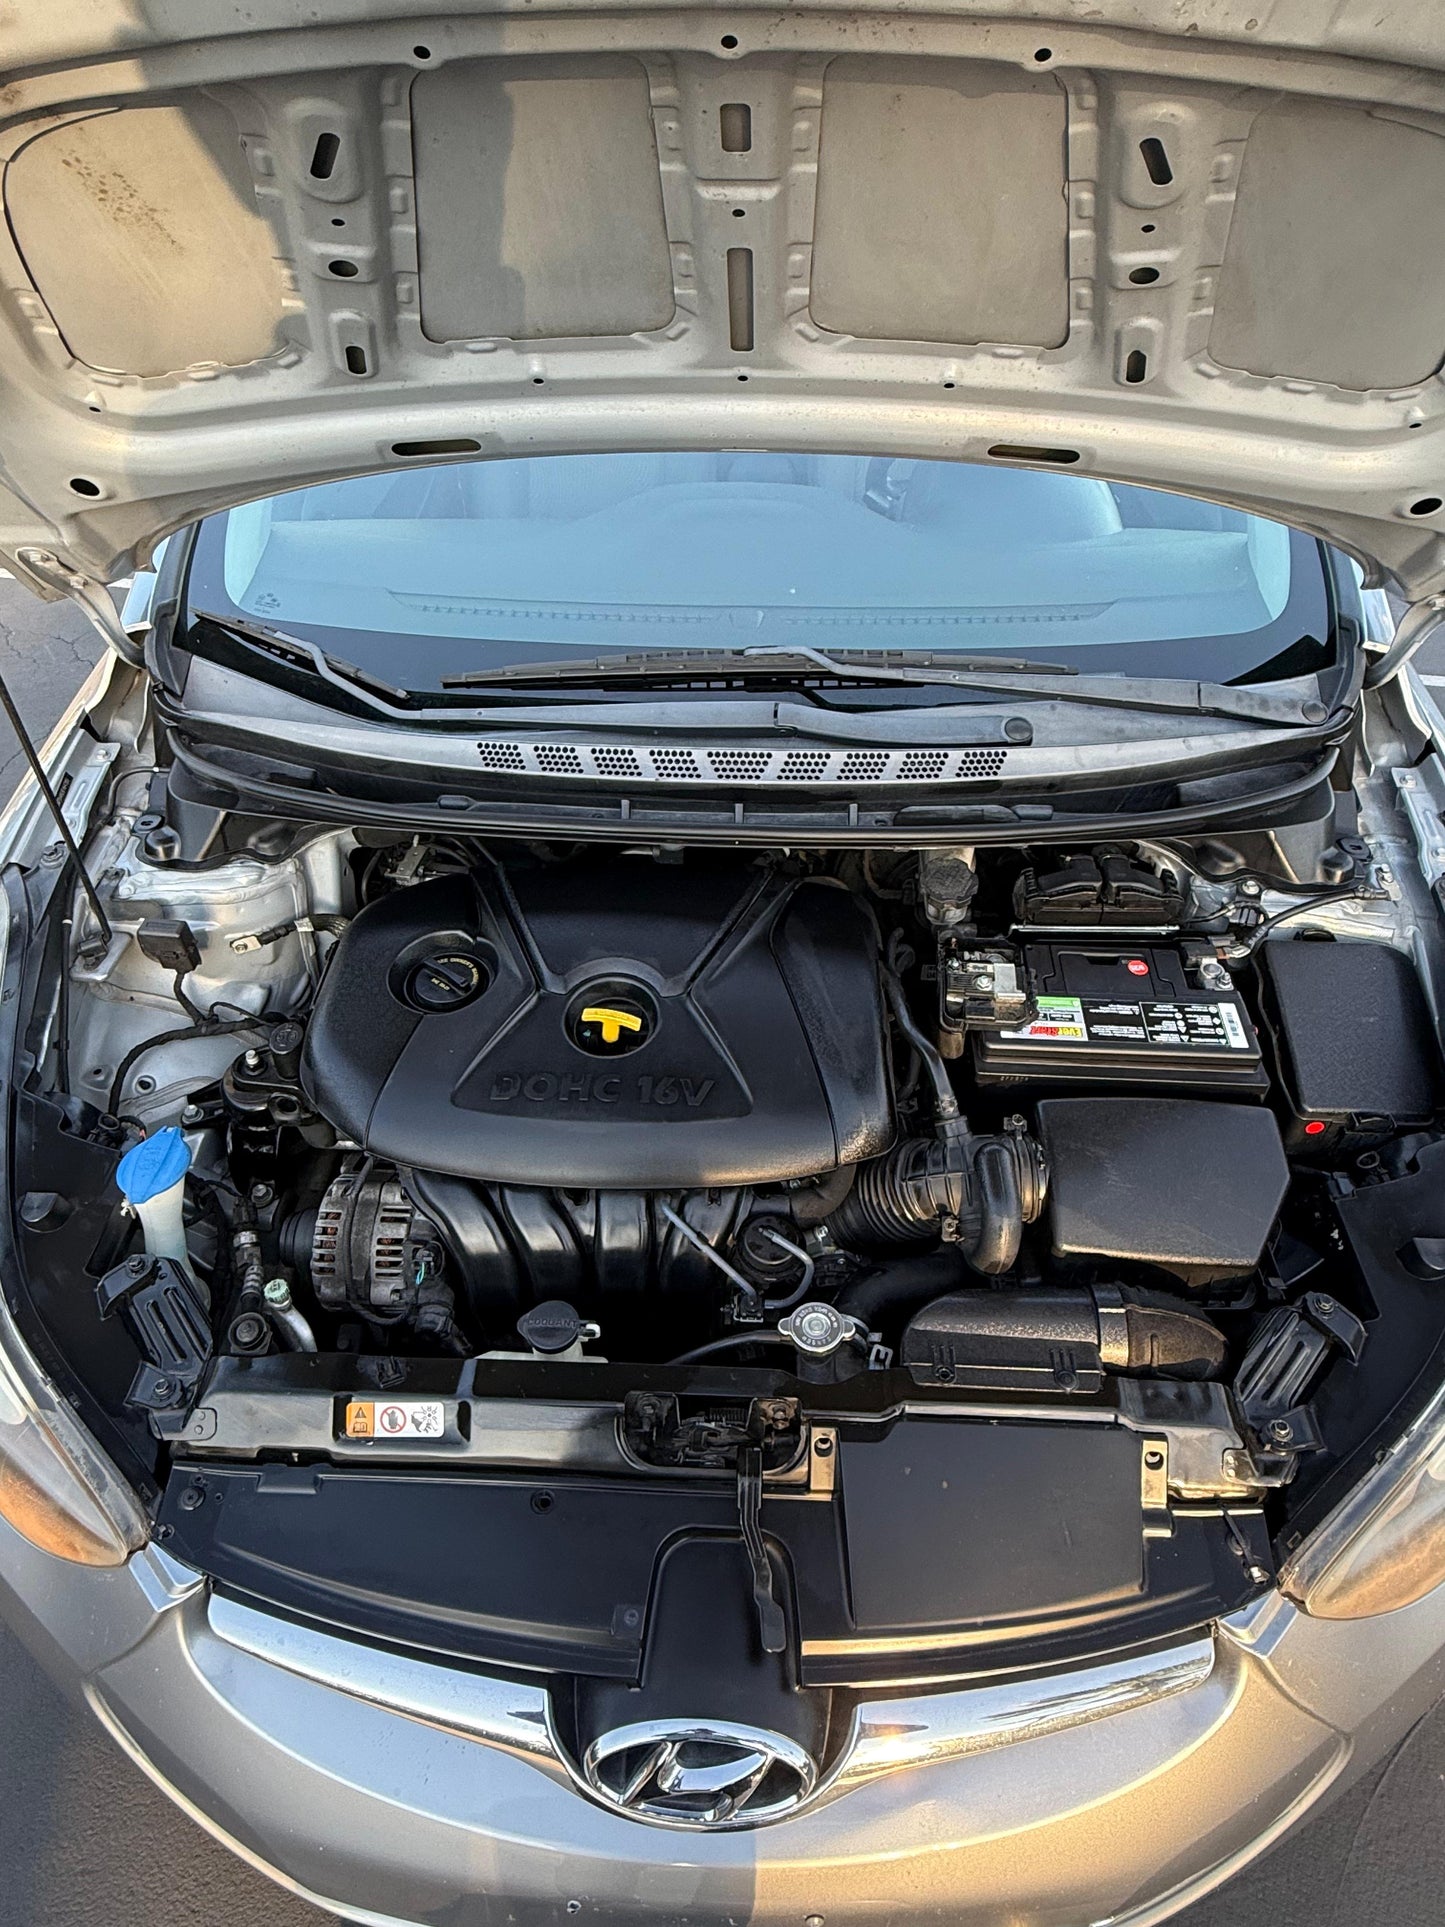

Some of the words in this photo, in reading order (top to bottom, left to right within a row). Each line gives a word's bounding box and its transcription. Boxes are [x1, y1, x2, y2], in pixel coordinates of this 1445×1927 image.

[489, 1072, 621, 1103] DOHC
[637, 1075, 715, 1107] 16V
[527, 1317, 578, 1329] COOLANT
